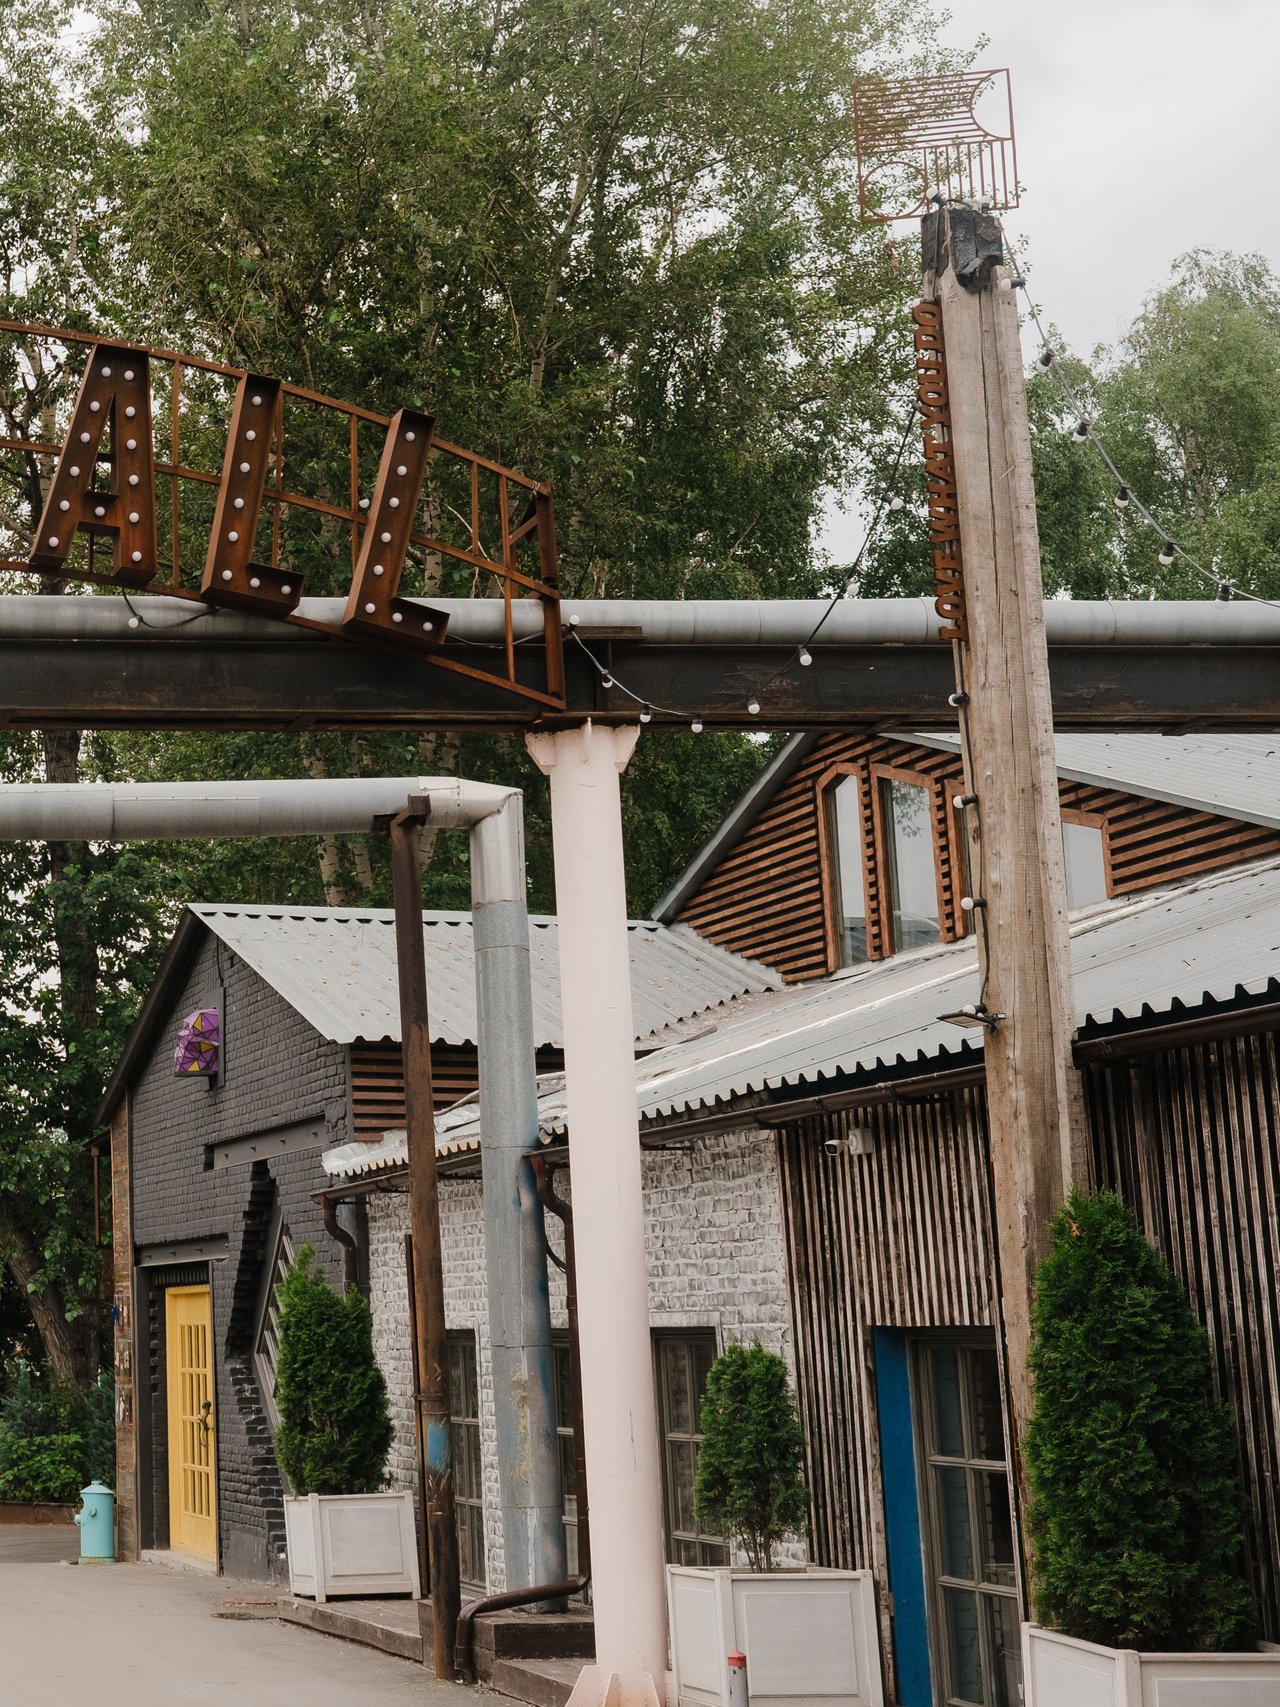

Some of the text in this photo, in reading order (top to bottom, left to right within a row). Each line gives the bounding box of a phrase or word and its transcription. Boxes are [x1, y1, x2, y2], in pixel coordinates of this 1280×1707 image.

[912, 303, 969, 642] LOVE WHAT YOU DO
